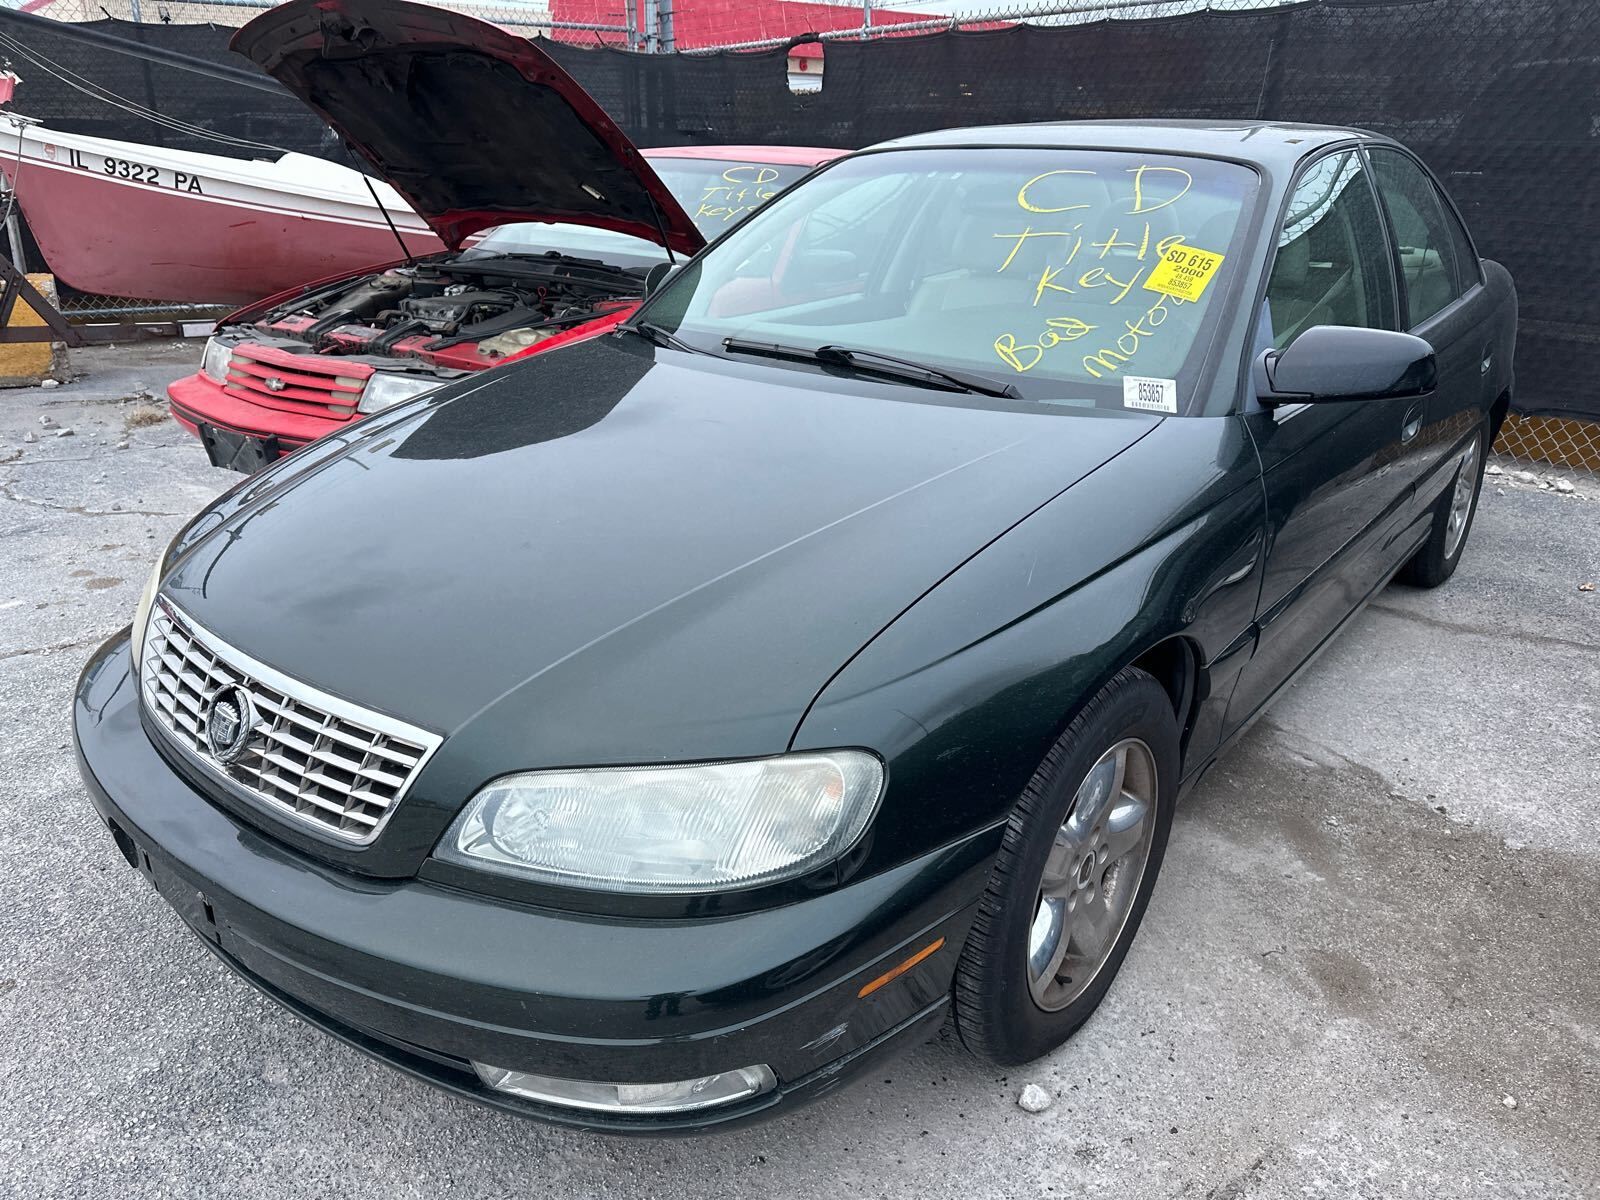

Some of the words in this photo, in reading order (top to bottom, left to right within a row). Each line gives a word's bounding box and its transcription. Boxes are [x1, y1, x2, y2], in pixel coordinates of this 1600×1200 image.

[69, 148, 89, 170] IL
[103, 157, 160, 186] 9322
[174, 171, 203, 194] PA
[722, 166, 779, 184] CD
[702, 186, 777, 202] Title
[992, 222, 1186, 273] Title
[1166, 249, 1187, 264] SD
[1187, 254, 1215, 271] 615
[1173, 265, 1205, 278] 2000
[1033, 265, 1145, 307] Key
[1167, 278, 1193, 290] 853857
[994, 317, 1100, 373] Bad
[1138, 382, 1164, 403] 853857
